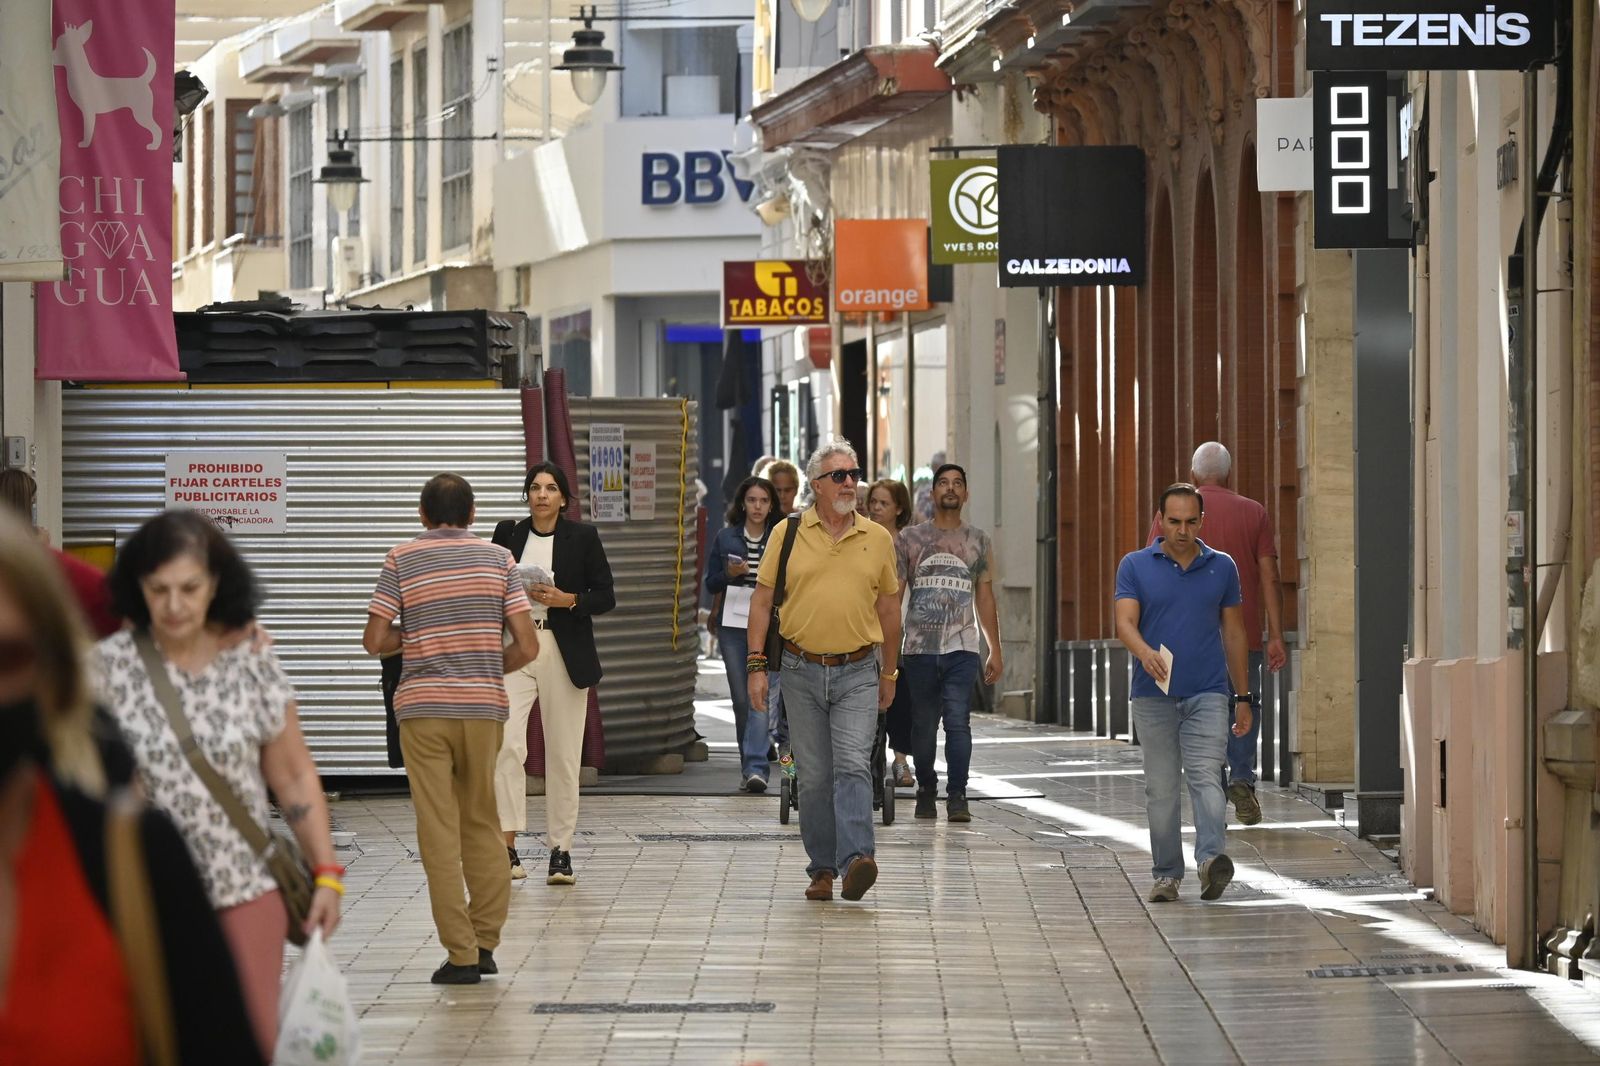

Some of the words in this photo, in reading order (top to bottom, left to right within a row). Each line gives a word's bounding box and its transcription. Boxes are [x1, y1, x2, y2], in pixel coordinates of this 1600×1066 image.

[59, 175, 145, 216] CHI
[943, 242, 974, 251] YVES
[1006, 258, 1131, 274] CALZEDONIA
[54, 267, 160, 306] GUA
[840, 288, 918, 308] orange
[729, 297, 824, 316] TABACOS
[188, 463, 263, 473] PROHIBIDO
[170, 478, 209, 487] FIJAR
[212, 478, 282, 487] CARTELES
[175, 492, 278, 501] PUBLICITARIOS
[914, 577, 972, 591] CALIFORNIA
